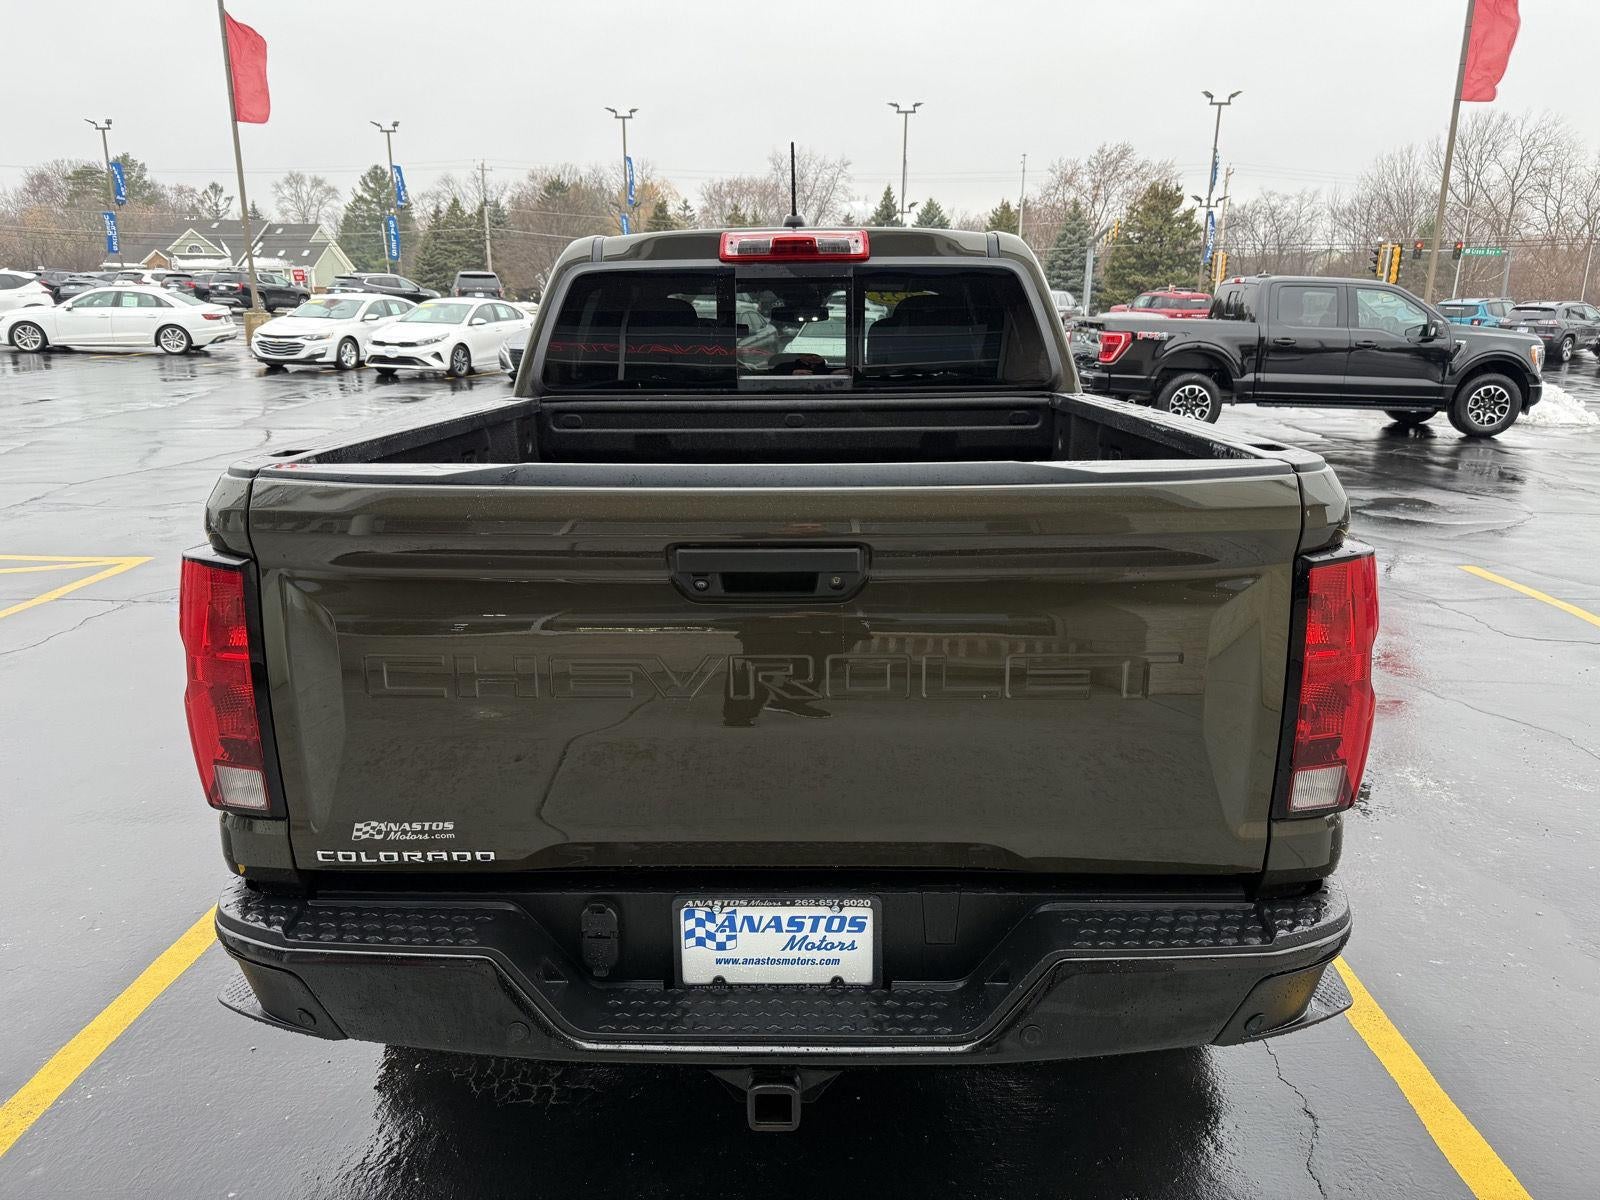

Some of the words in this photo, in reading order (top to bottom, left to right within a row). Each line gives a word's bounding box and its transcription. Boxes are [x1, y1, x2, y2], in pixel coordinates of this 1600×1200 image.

[389, 220, 397, 256] SALES
[364, 652, 1184, 699] CHEVROLET
[374, 821, 454, 832] ANASTOS
[316, 850, 496, 863] COLORADO
[794, 900, 872, 908] 262-657-6020
[714, 913, 868, 934] ANASTOS
[779, 935, 858, 952] Motors
[715, 957, 841, 967] www.anastosmotors.com
